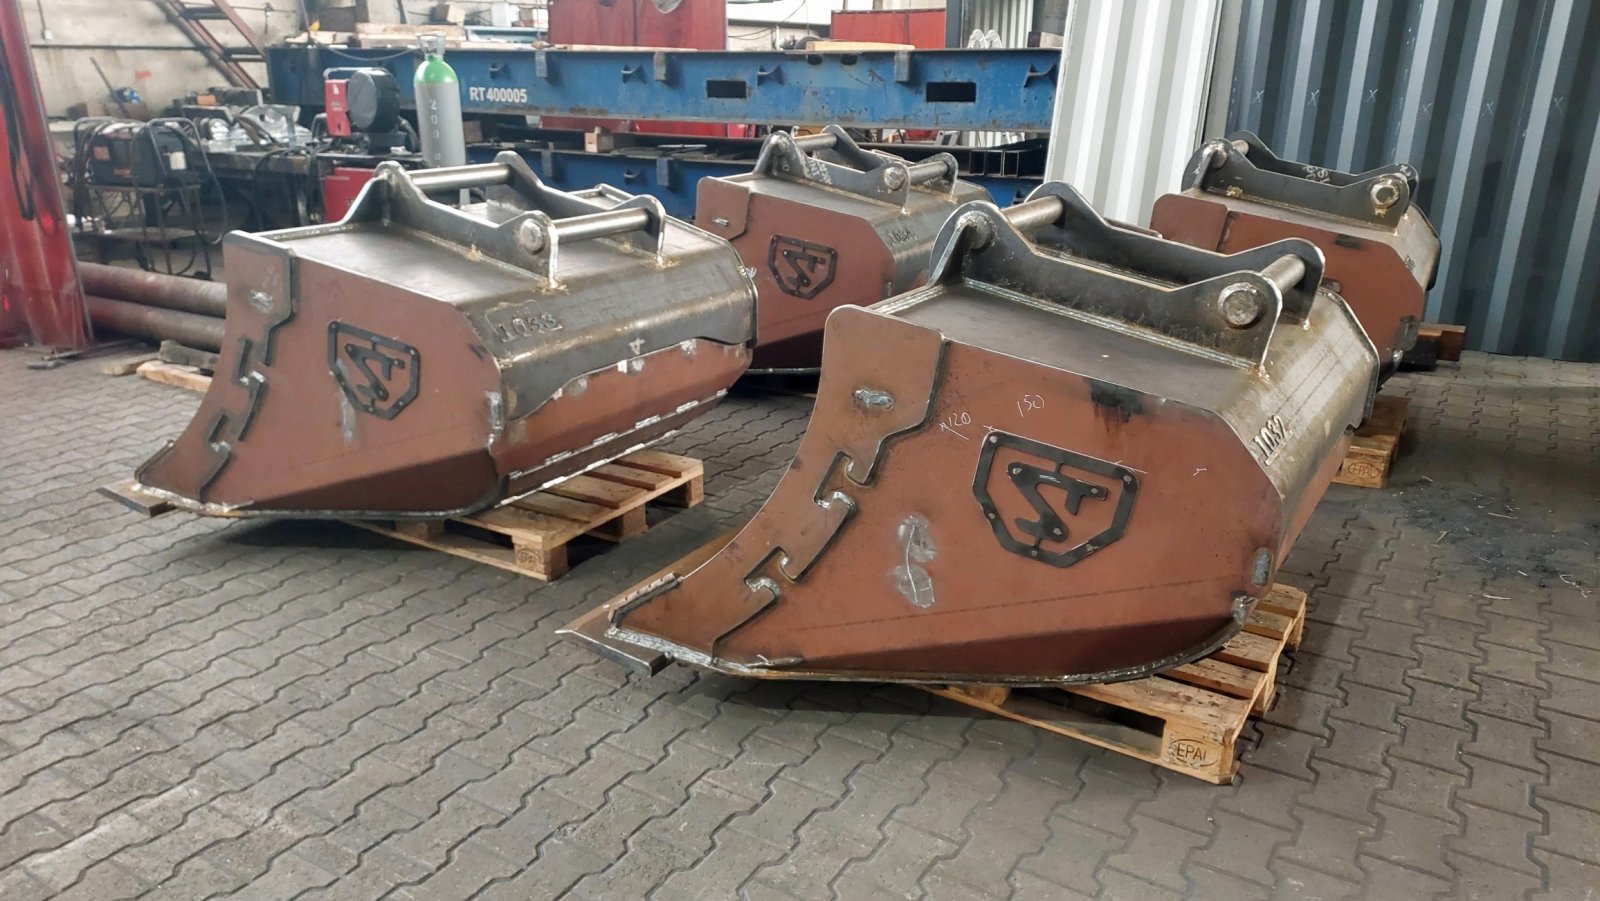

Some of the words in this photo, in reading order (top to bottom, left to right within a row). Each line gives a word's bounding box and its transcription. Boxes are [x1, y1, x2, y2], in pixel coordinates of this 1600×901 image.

[469, 86, 485, 101] RT
[486, 87, 528, 103] 400005
[1017, 394, 1045, 417] 150
[1253, 415, 1291, 465] 1032
